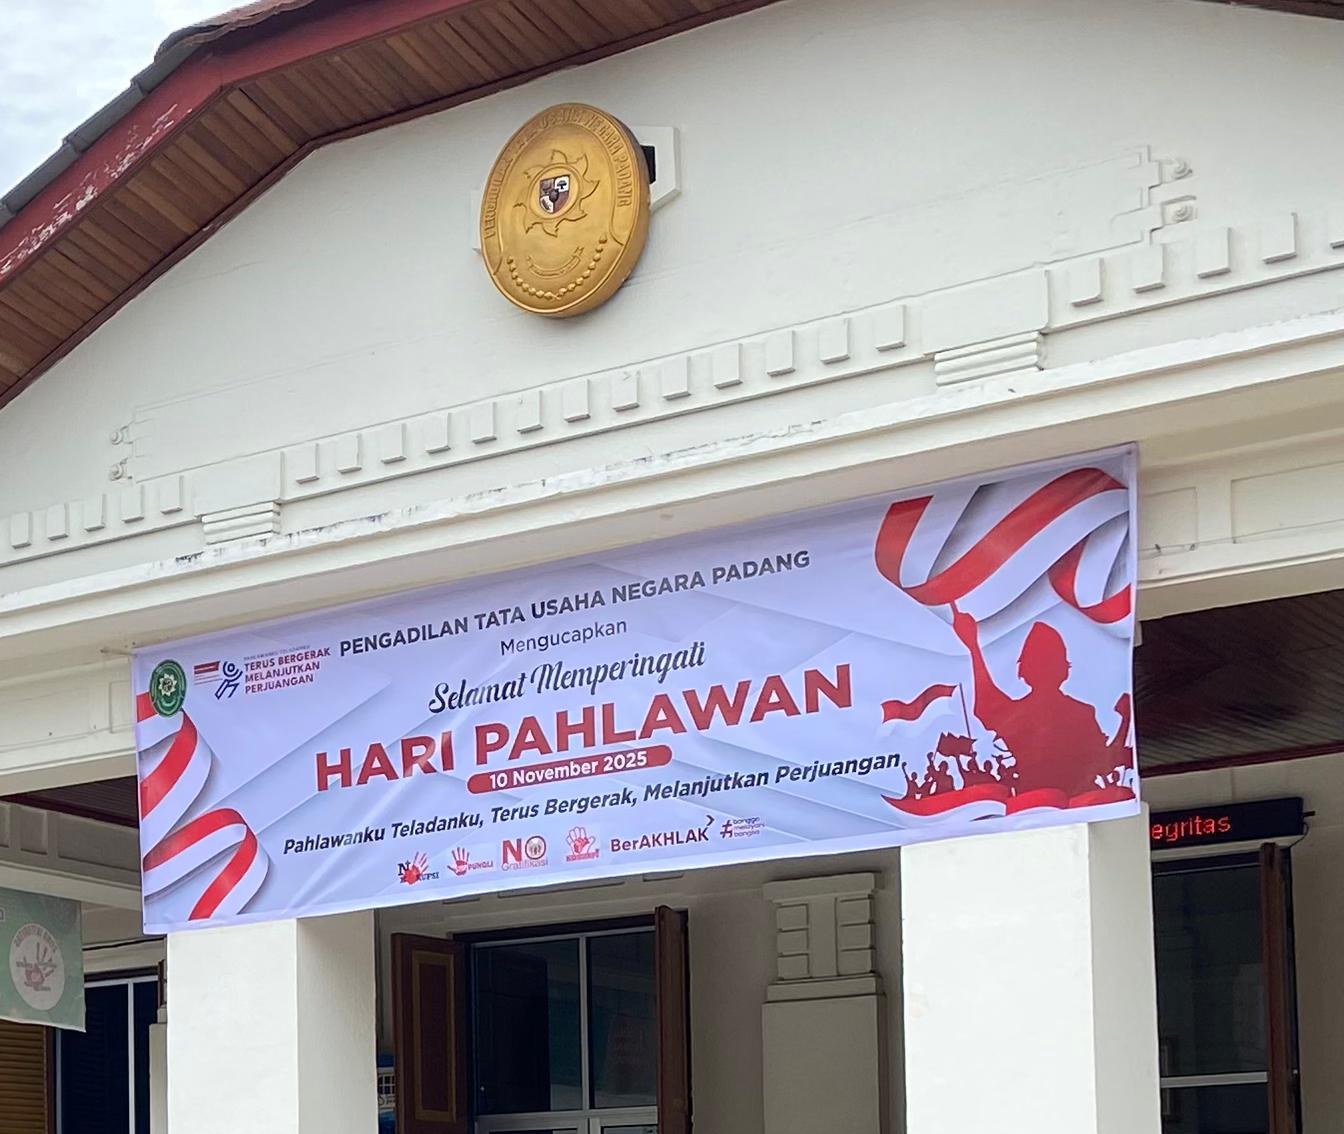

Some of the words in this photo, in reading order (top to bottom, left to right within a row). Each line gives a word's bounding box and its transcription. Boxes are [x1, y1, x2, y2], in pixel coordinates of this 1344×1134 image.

[340, 617, 469, 656] PENGADILAN
[474, 606, 526, 631] TATA
[531, 590, 606, 619] USAHA
[612, 571, 706, 604] NEGARA
[712, 550, 810, 585] PADANG
[500, 620, 628, 656] Mengucapkan
[244, 658, 276, 671] TERUS
[278, 647, 331, 666] BERGERAK
[245, 661, 320, 683] MELANJUTKAN
[245, 674, 314, 694] PERJUANGAN
[428, 671, 528, 714] Selamat
[529, 641, 706, 696] Memperingati
[316, 730, 455, 792] HARI
[474, 663, 853, 766] PAHLAWAN
[489, 773, 508, 789] 10
[512, 760, 599, 784] November
[603, 751, 648, 771] 2025
[283, 824, 385, 854] Pahlawanku
[391, 811, 484, 838] Teladanku,
[491, 803, 539, 823] Terus
[544, 788, 638, 815] Bergerak,
[643, 771, 769, 801] Melanjutkan
[774, 753, 900, 783] Perjuangan
[611, 826, 709, 852] BerAKHLAK
[1151, 814, 1232, 843] egritas
